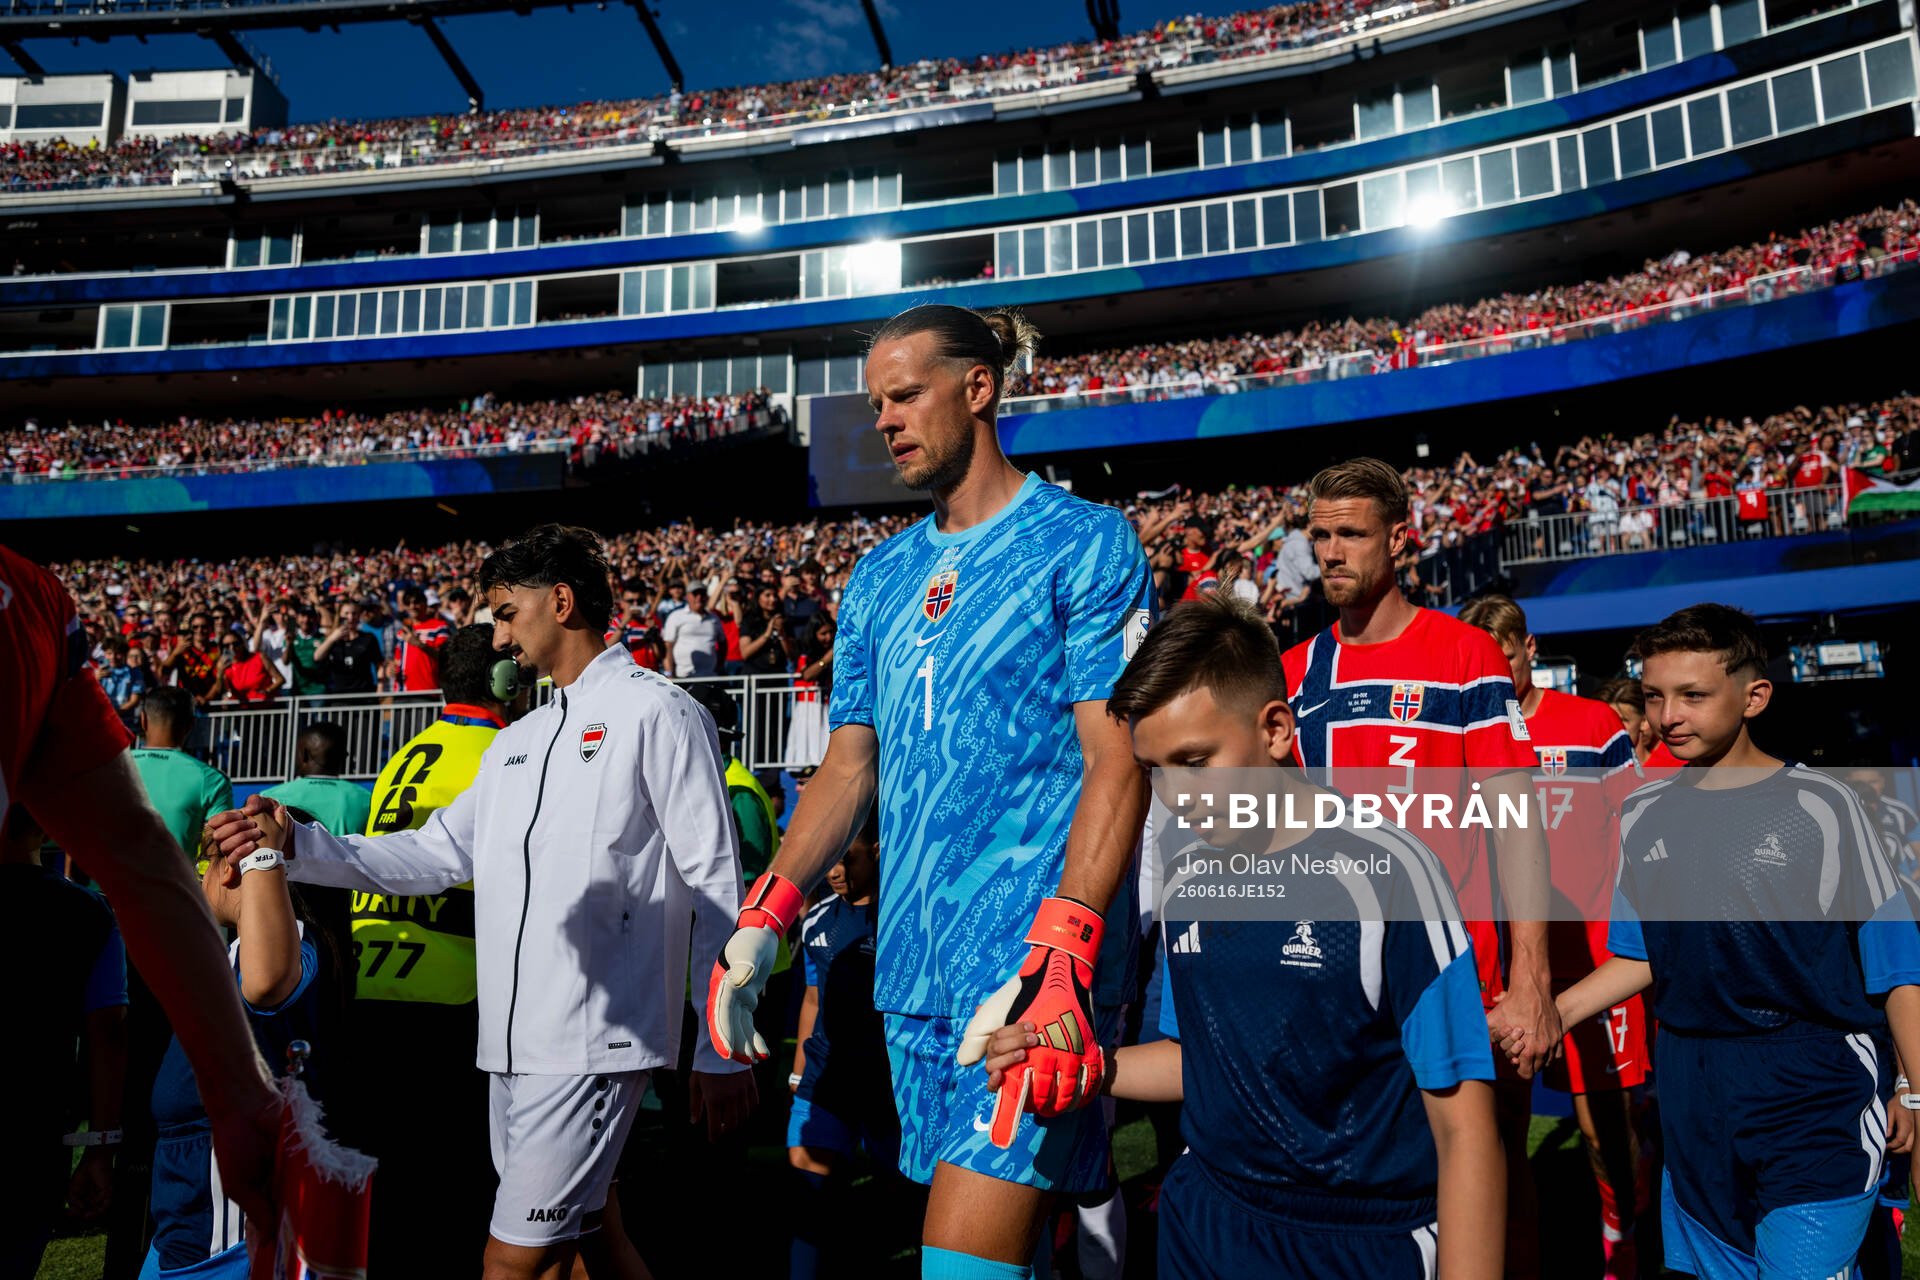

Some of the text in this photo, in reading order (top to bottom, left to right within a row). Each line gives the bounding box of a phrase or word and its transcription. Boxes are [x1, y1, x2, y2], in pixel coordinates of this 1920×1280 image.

[917, 656, 934, 730] 1
[504, 754, 528, 766] JAKO
[1387, 734, 1417, 794] 3
[379, 813, 397, 823] FIFA
[1536, 787, 1574, 830] 17
[255, 854, 274, 863] FIFA
[351, 890, 448, 922] URITY
[1282, 944, 1322, 958] QUAKER
[1597, 1006, 1628, 1054] 17
[526, 1208, 567, 1222] JAKO
